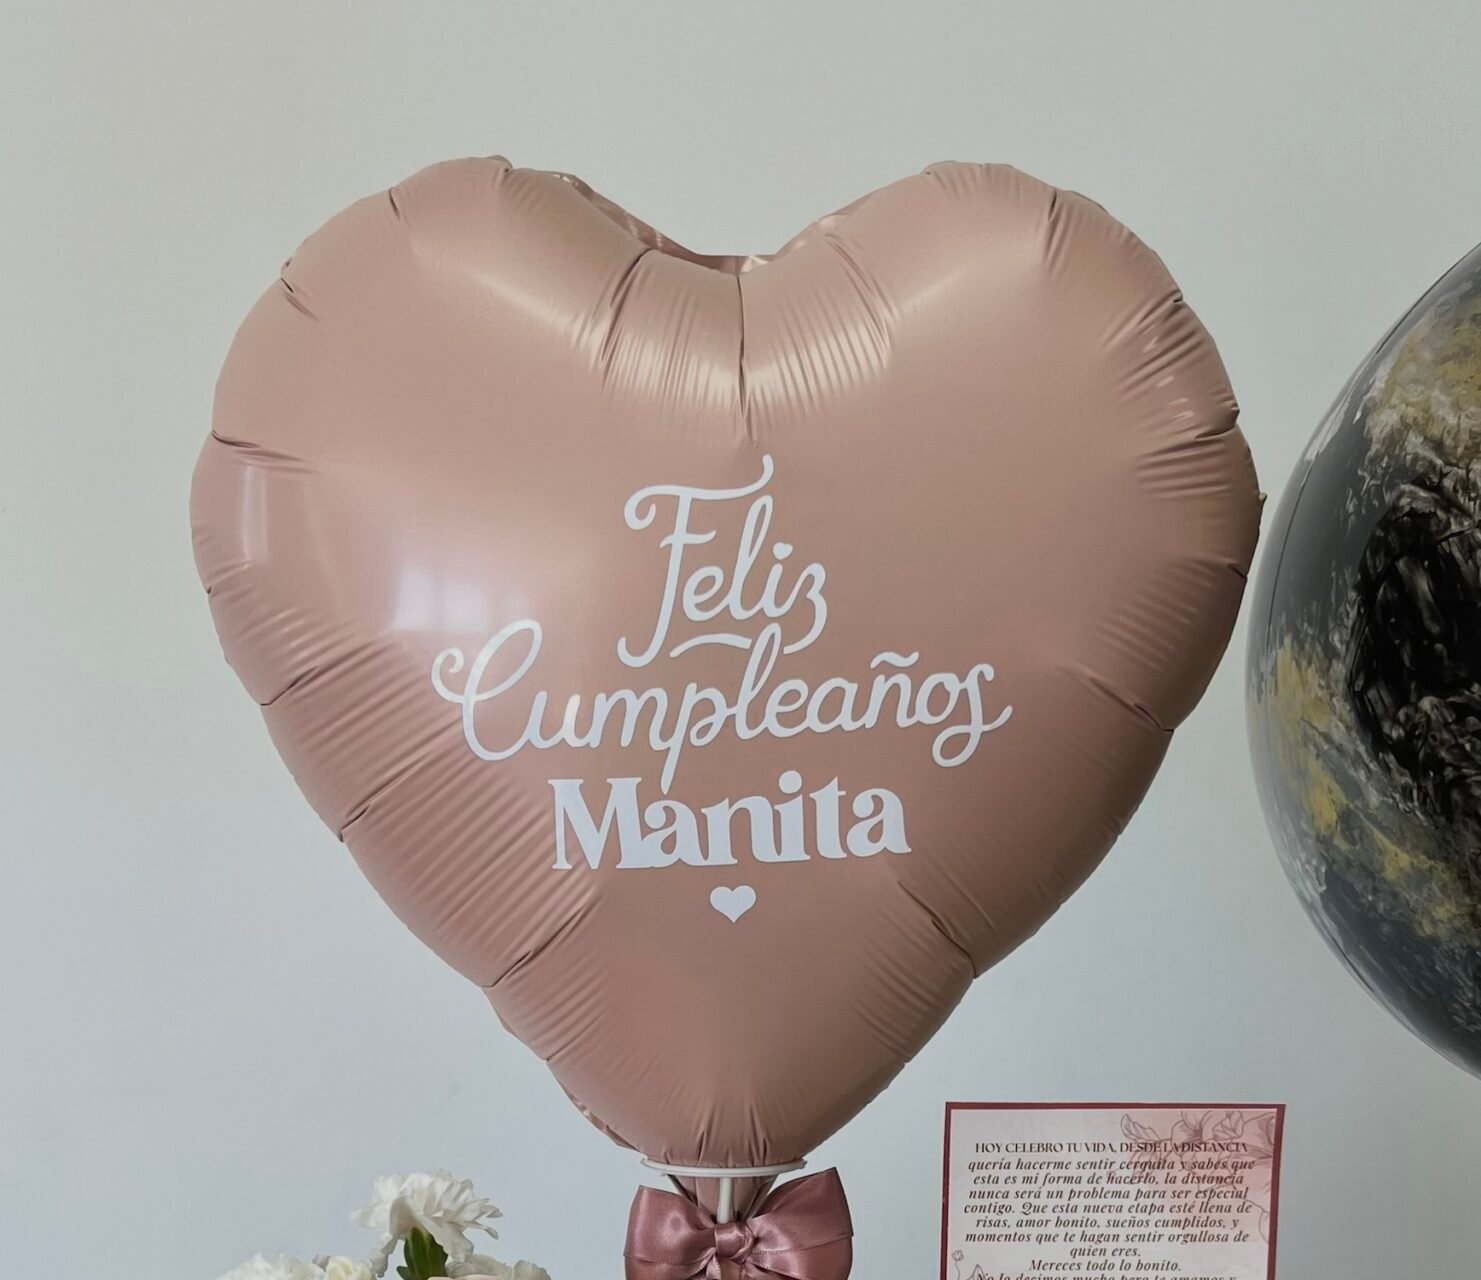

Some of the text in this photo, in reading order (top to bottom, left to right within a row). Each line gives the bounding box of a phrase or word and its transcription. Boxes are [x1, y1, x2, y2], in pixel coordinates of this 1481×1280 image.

[617, 454, 828, 668] Feliz
[431, 619, 1013, 795] Cumpleaños
[547, 770, 912, 870] Manita
[976, 1142, 1004, 1153] HOY
[1006, 1142, 1064, 1153] CELEBRO
[1066, 1142, 1083, 1152] TU
[1120, 1142, 1161, 1153] DESDE
[1164, 1142, 1181, 1152] LA
[1182, 1142, 1248, 1153] DISTANCIA
[968, 1158, 1255, 1172] quería hacerme sentir cerquita y sabes que
[973, 1174, 999, 1185] esta
[1004, 1176, 1017, 1185] es
[1022, 1173, 1039, 1185] mi
[1042, 1173, 1082, 1187] forma
[1087, 1173, 1102, 1185] de
[1164, 1173, 1176, 1184] la
[1181, 1172, 1243, 1184] distancia
[969, 1190, 1009, 1199] nunca
[1046, 1190, 1064, 1199] un
[1068, 1187, 1129, 1201] problema
[1134, 1189, 1166, 1201] para
[1170, 1189, 1191, 1199] ser
[1194, 1188, 1248, 1201] especial
[964, 1201, 1252, 1216] contigo. Que esta nueva etapa esté llena de
[976, 1216, 1010, 1229] risas,
[1016, 1218, 1051, 1228] amor
[1105, 1216, 1150, 1228] sueños
[1232, 1219, 1239, 1230] y
[965, 1231, 1249, 1244] momentos que te hagan sentir orgullosa de
[1070, 1245, 1141, 1258] quien eres.
[1029, 1259, 1181, 1271] Mereces todo lo bonito.
